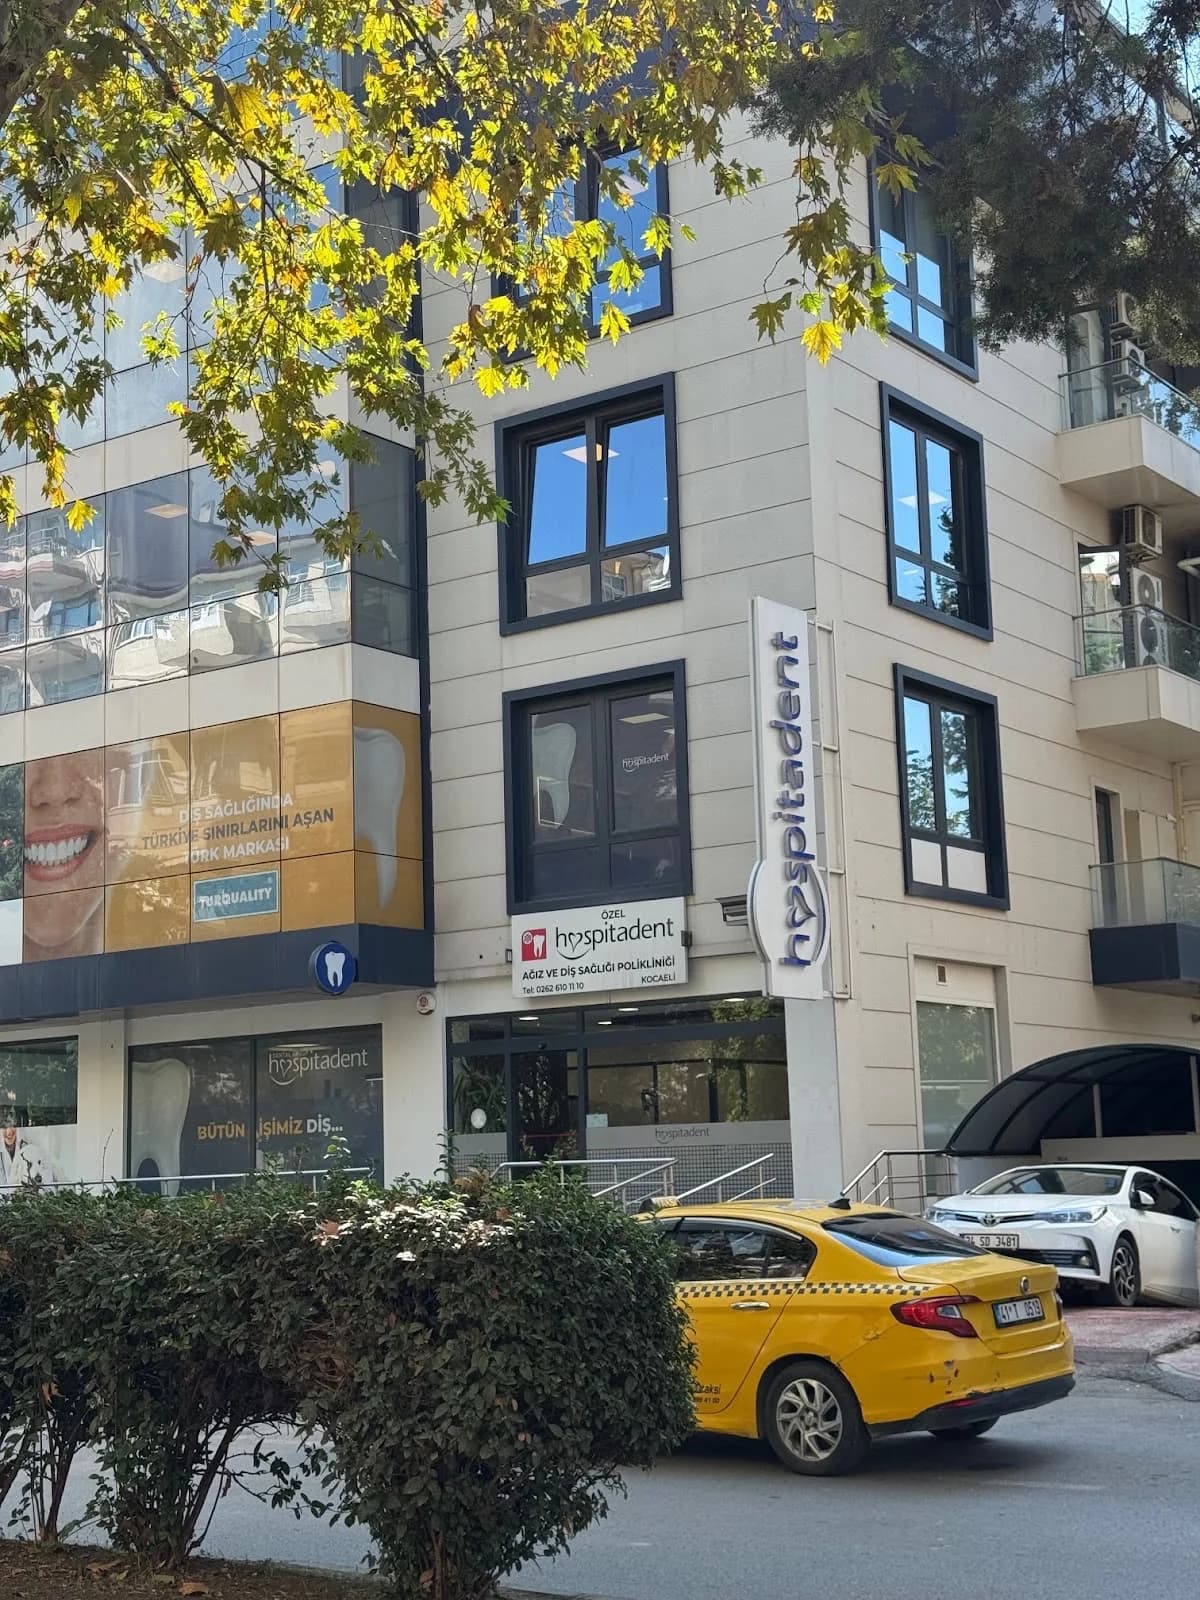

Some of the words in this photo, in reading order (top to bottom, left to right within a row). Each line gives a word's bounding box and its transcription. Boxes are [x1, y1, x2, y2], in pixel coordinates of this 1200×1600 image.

[622, 752, 669, 769] hospitadent
[179, 805, 201, 824] DŞ
[205, 793, 294, 819] SAĞLIĞINDA
[769, 630, 818, 968] hospitadent
[143, 827, 200, 850] TÜRKİYE
[203, 814, 288, 841] SINIRLARINI
[292, 807, 334, 829] AŞAN
[223, 836, 289, 860] MARKASI
[198, 887, 272, 909] TURQUALITY
[601, 909, 626, 920] ÖZEL
[555, 918, 674, 952] hospitadent
[522, 968, 544, 981] AĞIZ
[545, 968, 558, 979] VE
[560, 965, 576, 978] DİŞ
[578, 961, 615, 975] SAĞLIĞI
[617, 954, 675, 971] POLİKLİNİĞİ
[641, 972, 676, 984] KOCAELİ
[522, 986, 535, 995] Tel:
[536, 984, 554, 994] 0262
[555, 983, 567, 992] 610
[569, 982, 575, 991] 11
[576, 982, 585, 991] 10
[268, 1047, 368, 1078] hospitadent
[197, 1121, 245, 1140] BÜTÜN
[258, 1116, 304, 1141] İŞİMİZ
[655, 1127, 709, 1141] hospitadent
[980, 1236, 990, 1247] SD
[995, 1236, 1016, 1247] 3481
[1000, 1305, 1010, 1321] 41
[1012, 1303, 1020, 1319] T
[1024, 1299, 1041, 1317] 0519
